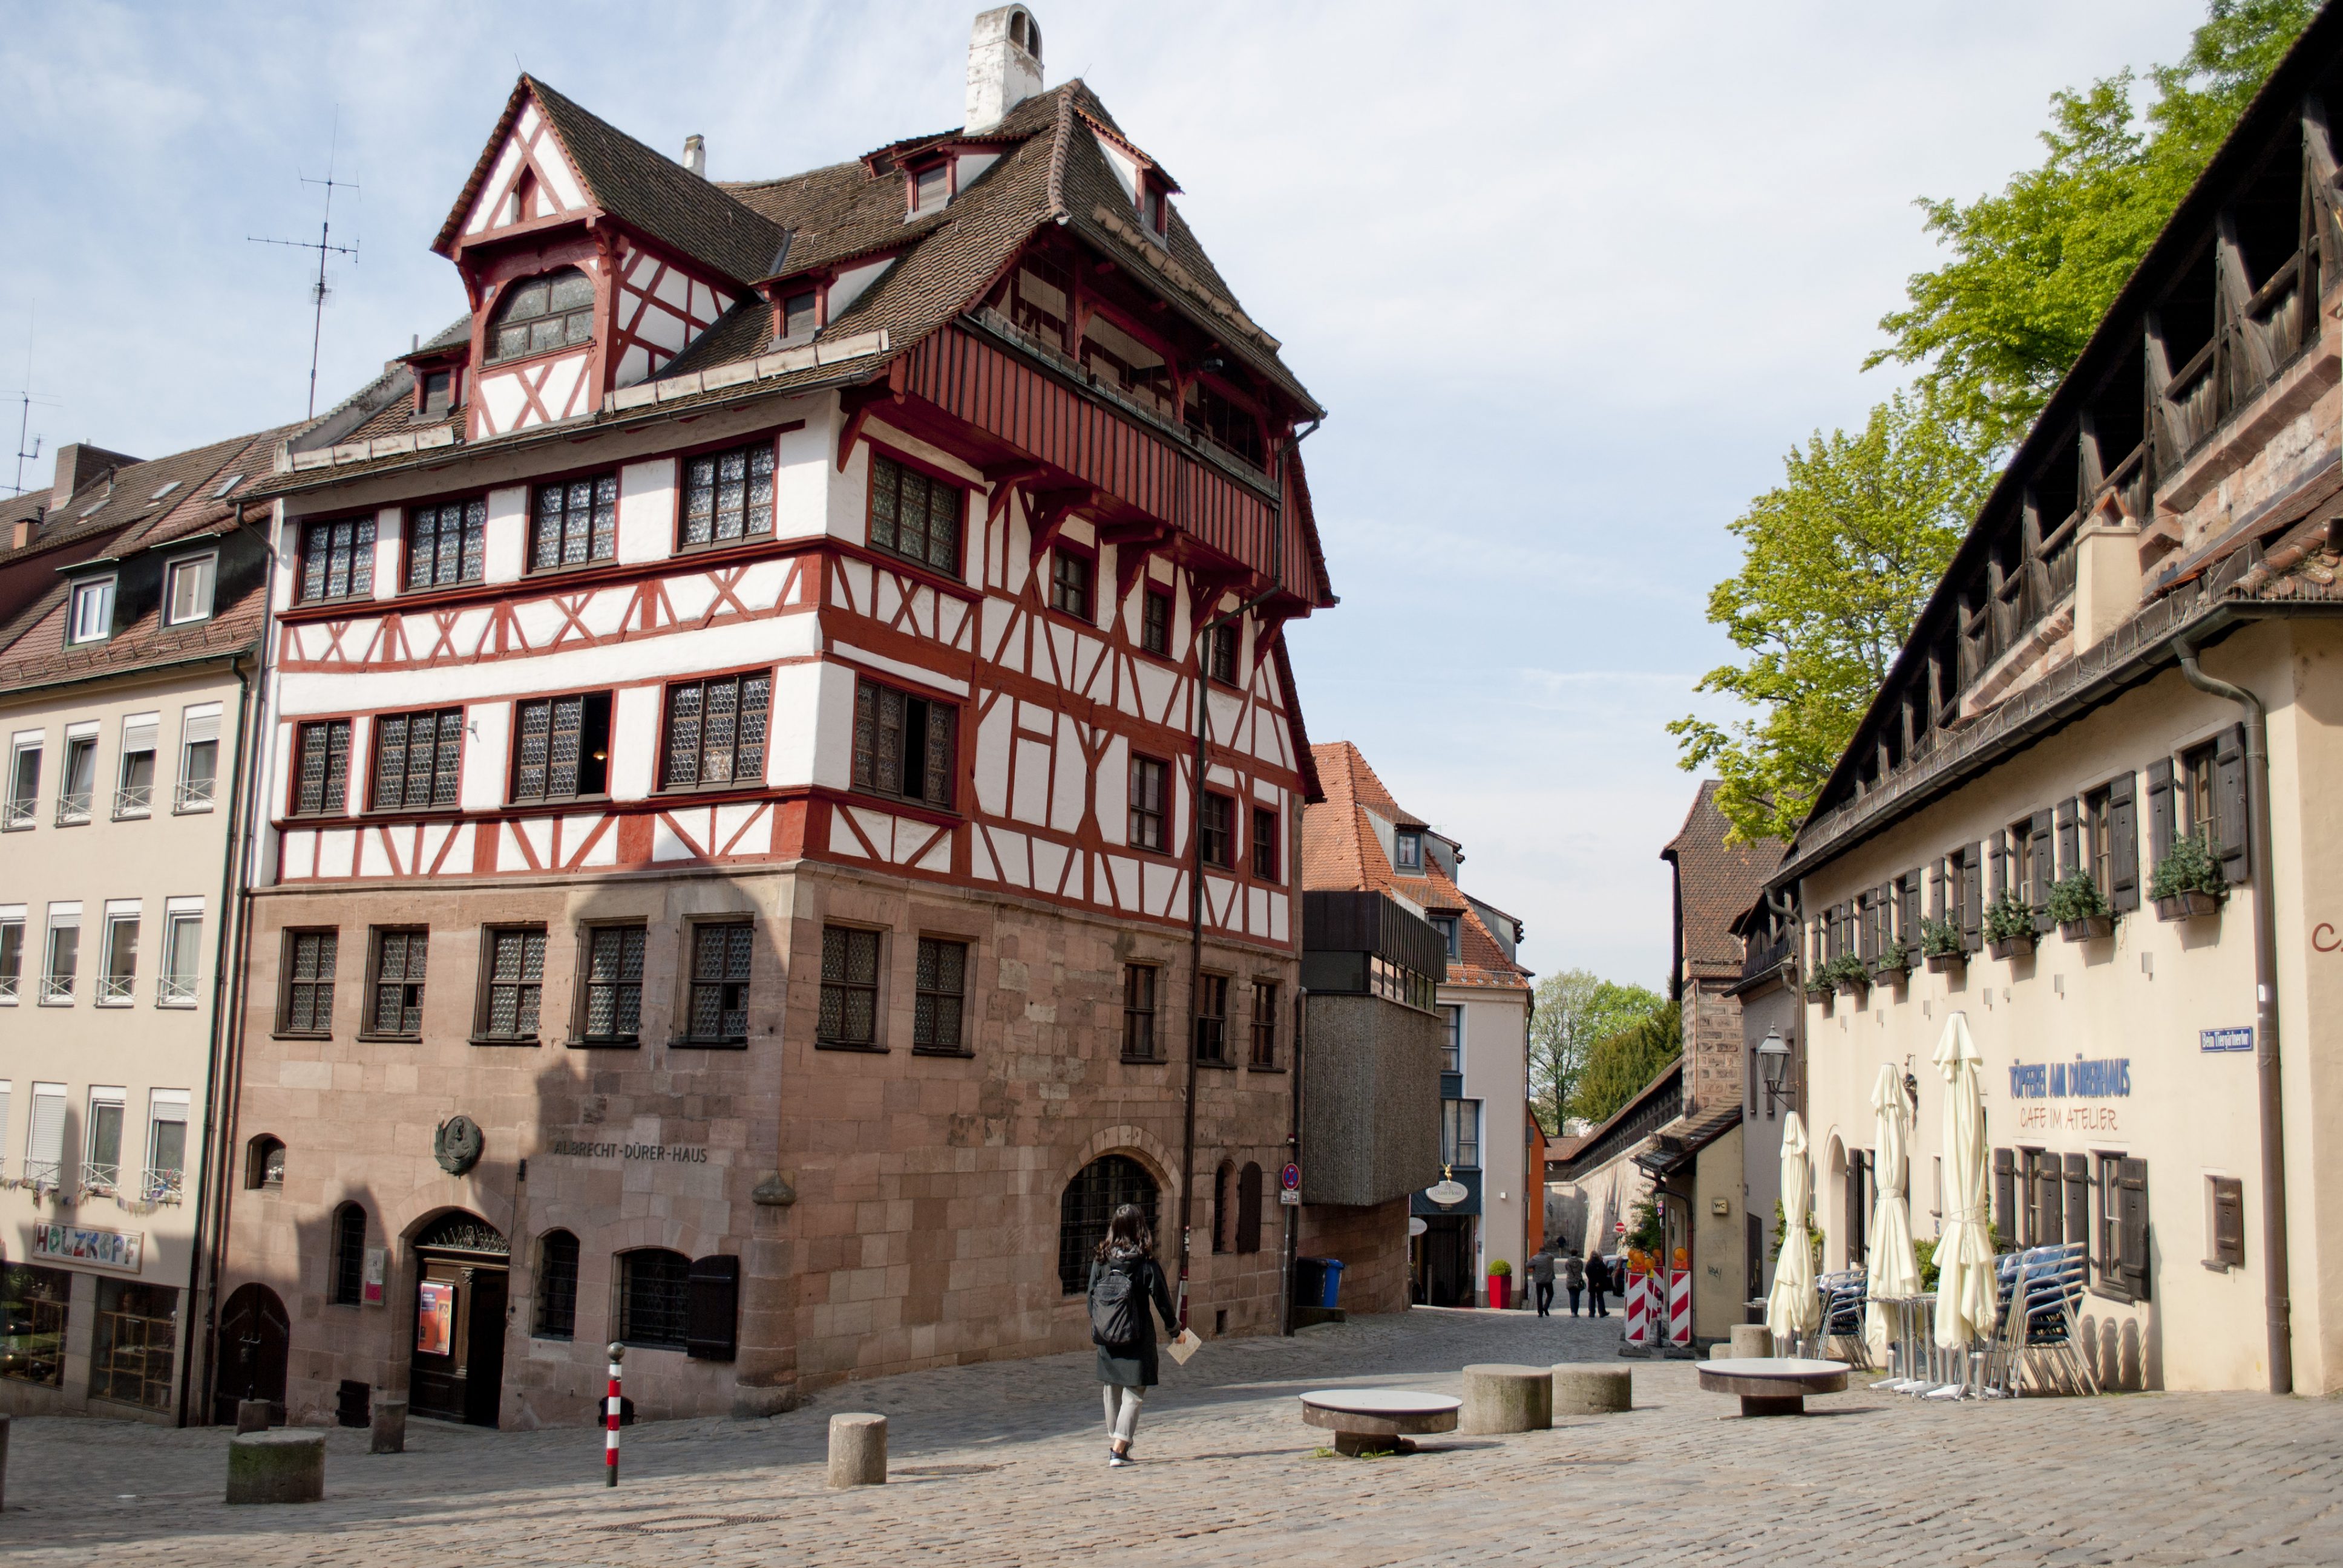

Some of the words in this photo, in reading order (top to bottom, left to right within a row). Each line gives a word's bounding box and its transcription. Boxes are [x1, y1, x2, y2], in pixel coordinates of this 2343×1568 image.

[2312, 923, 2343, 952] C
[2201, 1031, 2215, 1048] Beim
[2008, 1059, 2046, 1099] TÖPFEREI
[2049, 1063, 2066, 1099] AM
[2068, 1053, 2130, 1099] DÜRERHAUS
[2020, 1102, 2046, 1129] CAFÉ
[2050, 1108, 2062, 1130] IM
[2065, 1106, 2118, 1131] ATELIER
[554, 1141, 707, 1163] ALBRECHT-DÜRER-HAUS
[35, 1224, 139, 1265] HOLZKOPF
